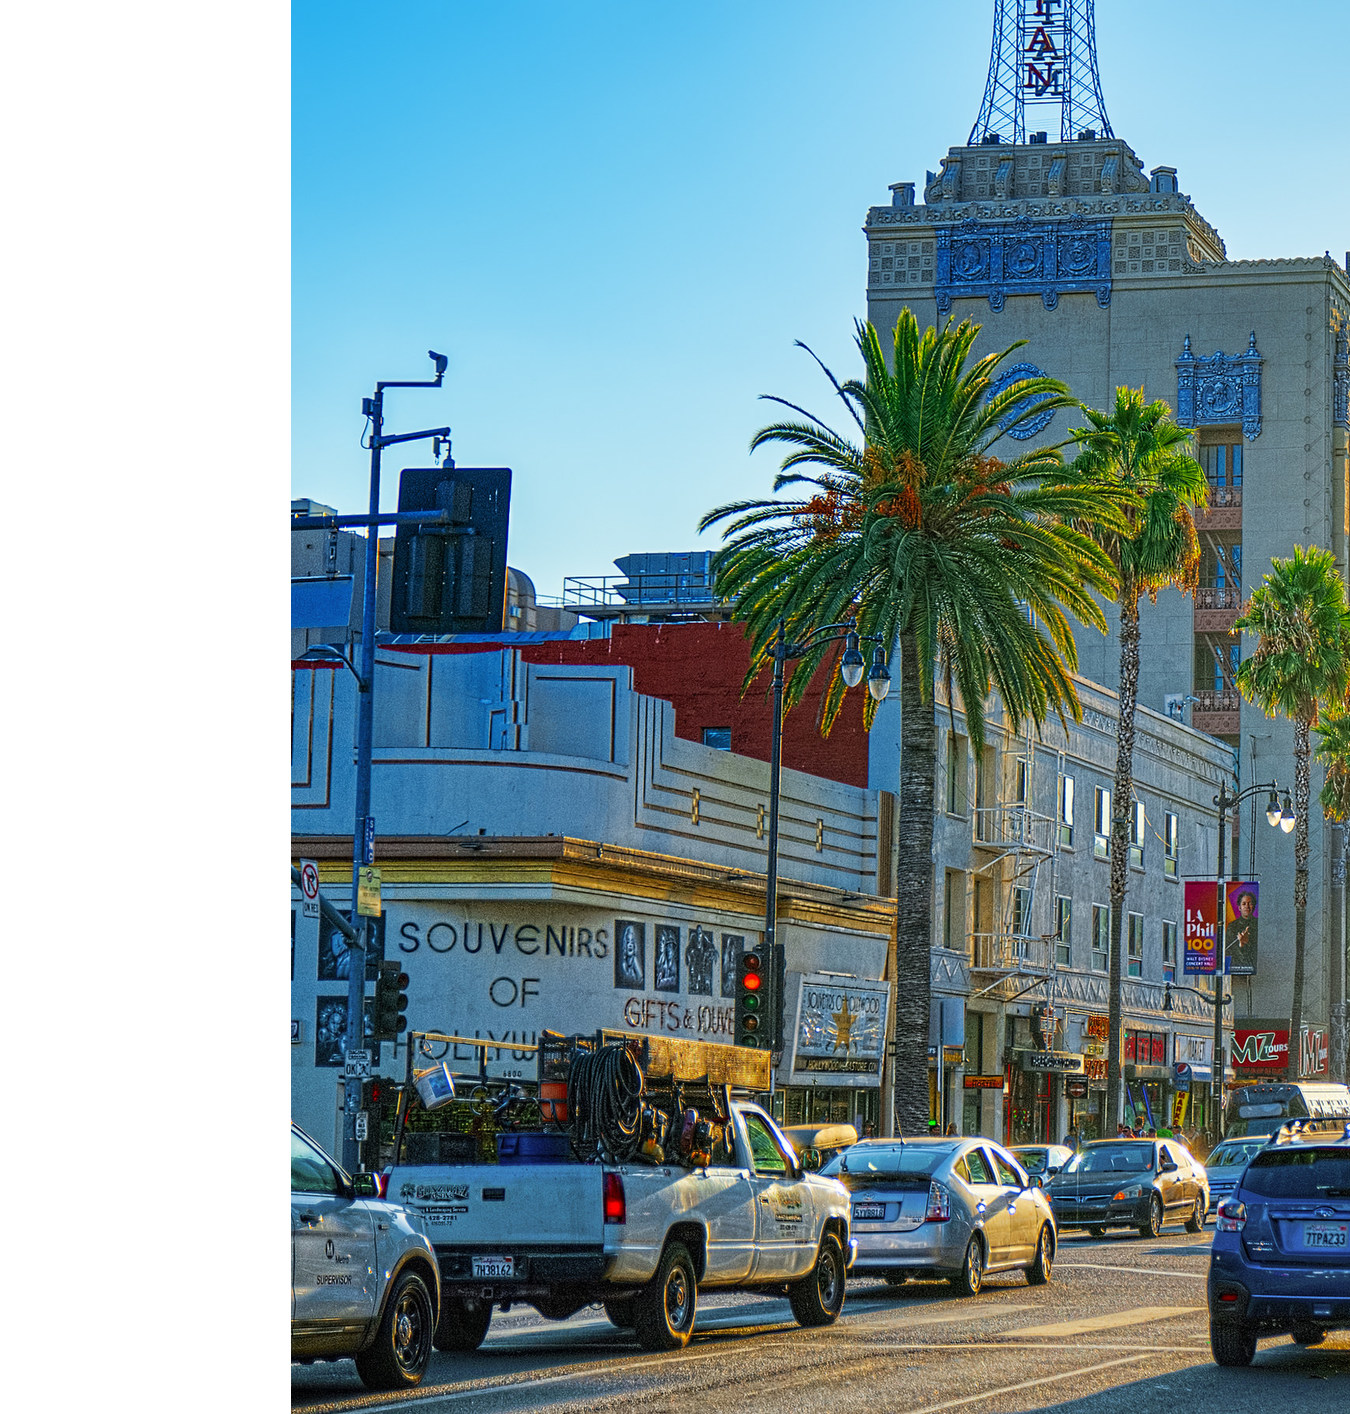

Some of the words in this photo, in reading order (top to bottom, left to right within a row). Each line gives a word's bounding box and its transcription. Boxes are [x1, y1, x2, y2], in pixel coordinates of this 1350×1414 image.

[1186, 909, 1204, 922] LA
[1186, 922, 1215, 937] Phil
[398, 921, 610, 959] SOUVENIRS
[1187, 938, 1215, 951] 100
[489, 976, 541, 1008] OF
[624, 996, 680, 1031] GIFTS
[682, 1008, 694, 1030] &
[1264, 1043, 1288, 1053] TOURS
[345, 1063, 356, 1075] OK
[503, 1070, 522, 1079] 6800
[1306, 1232, 1346, 1245] 7TPA233
[475, 1264, 511, 1276] 7H38162
[316, 1274, 352, 1286] SUPERVISOR
